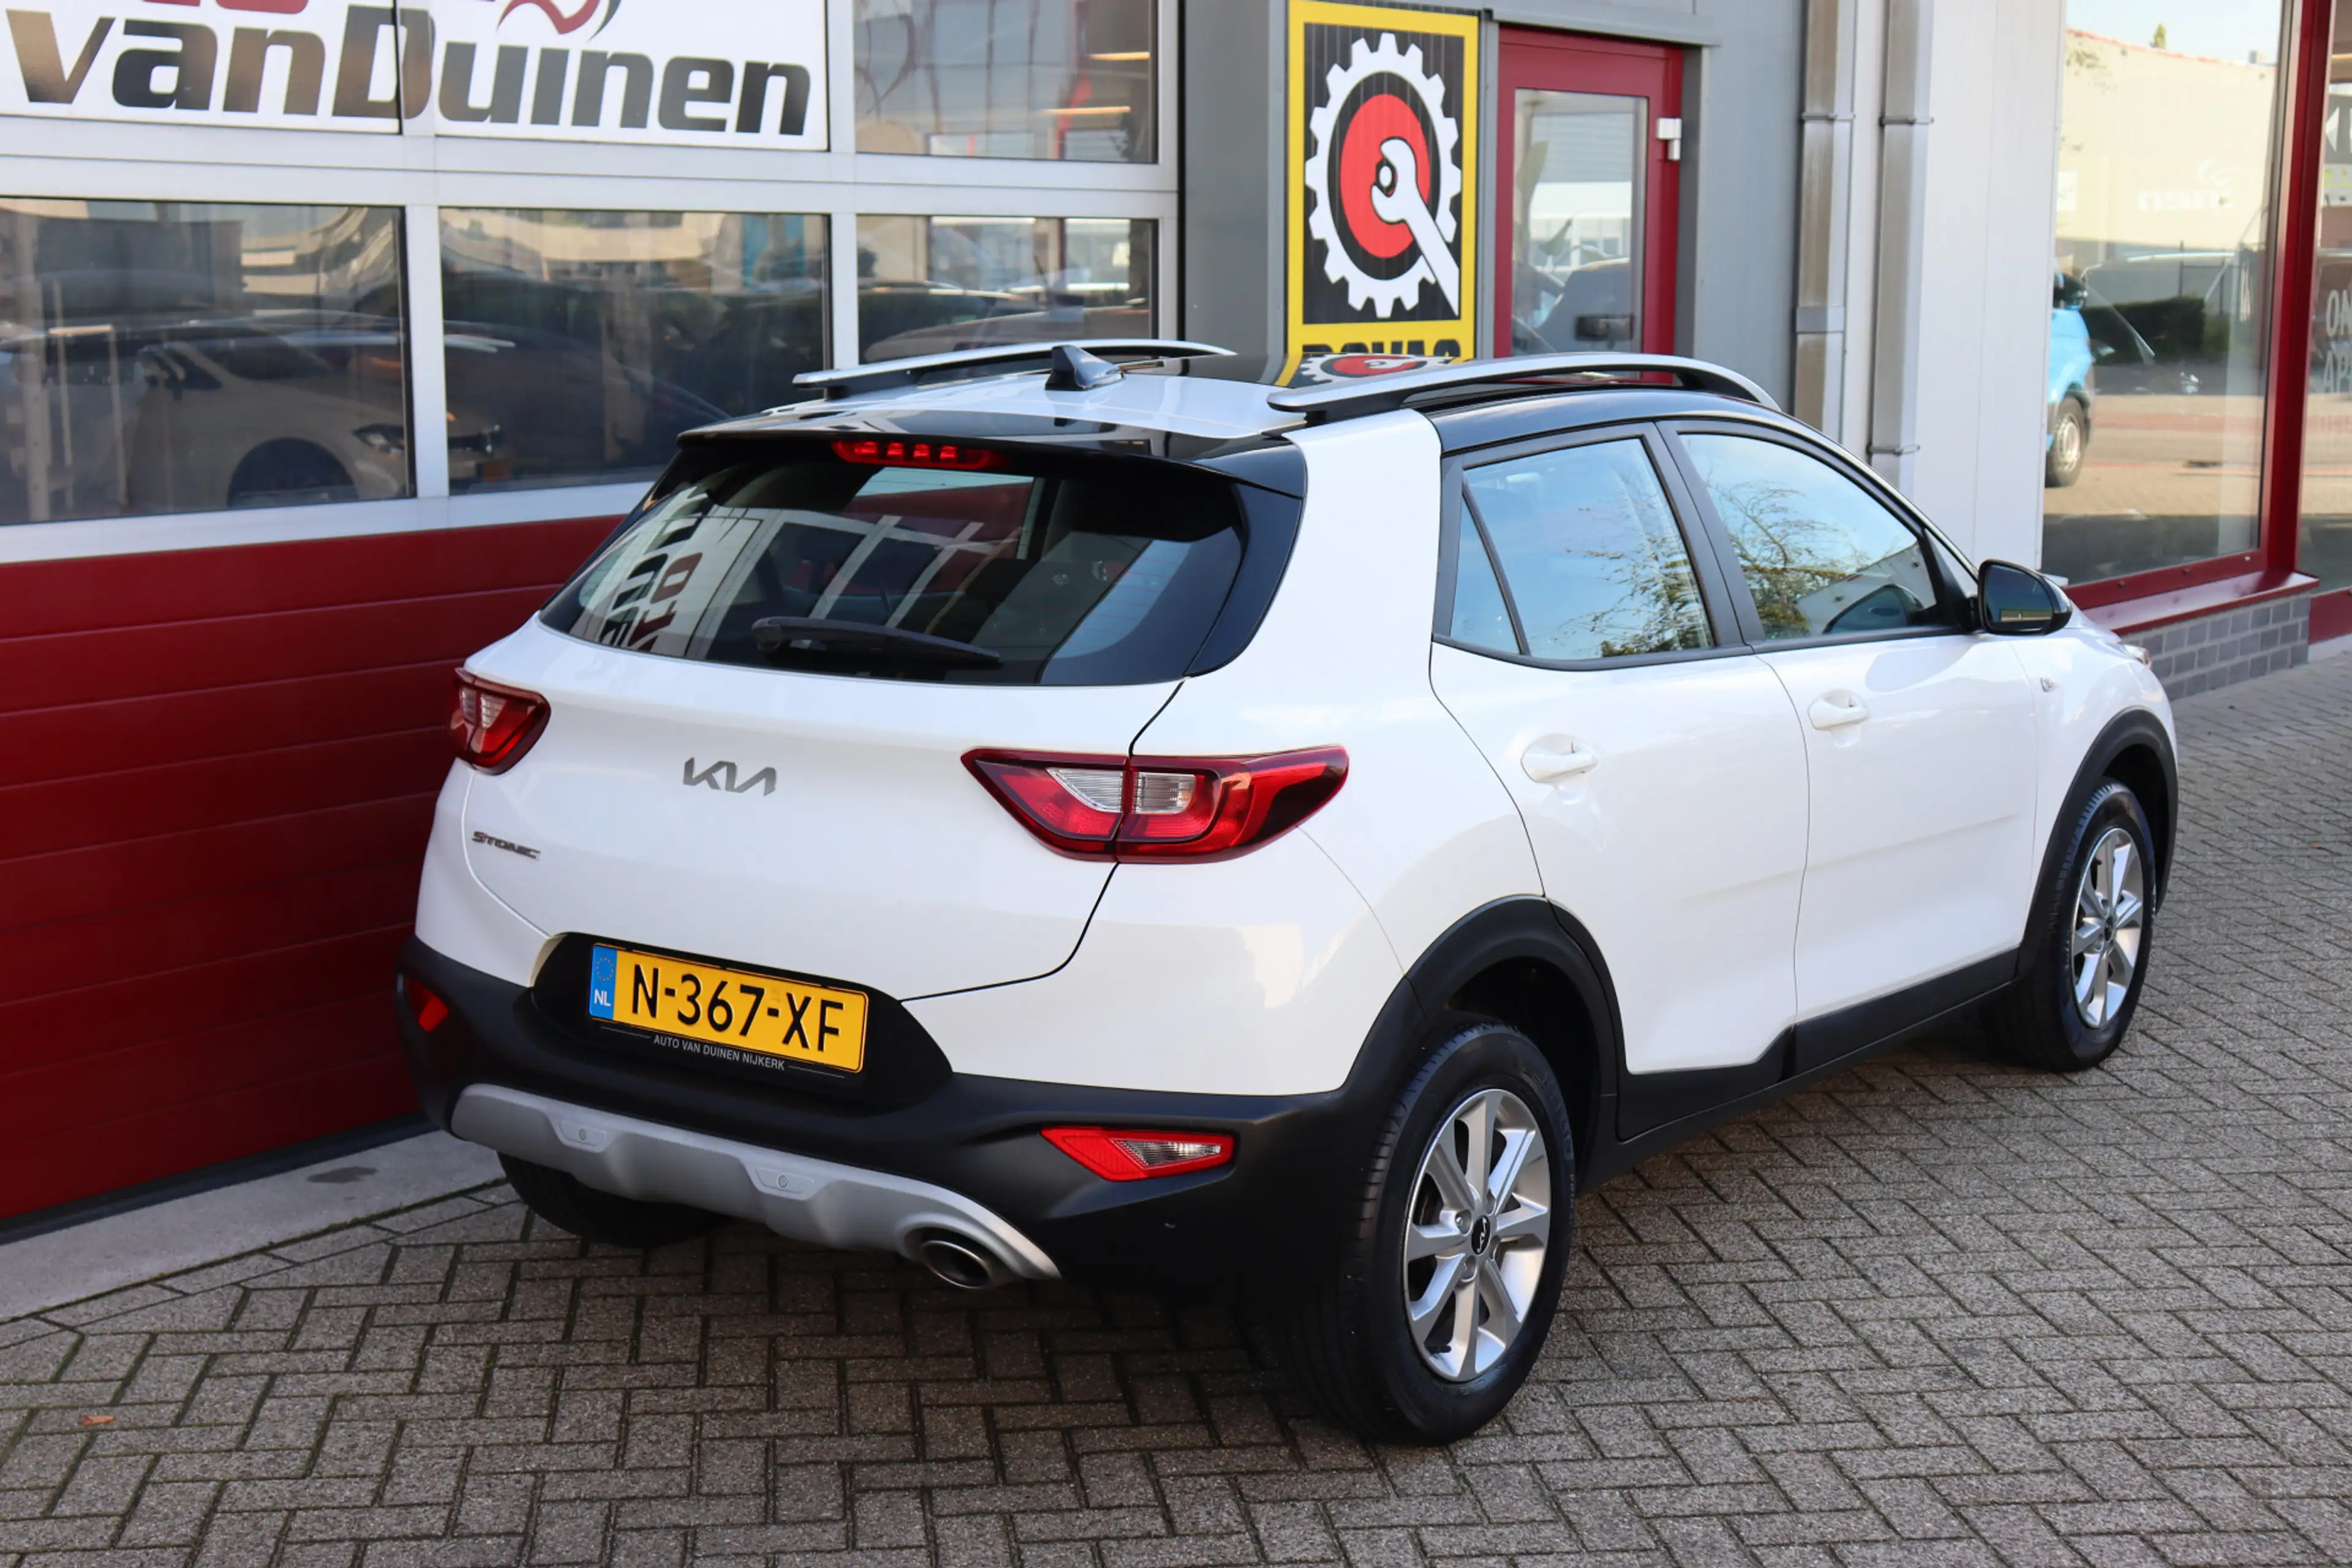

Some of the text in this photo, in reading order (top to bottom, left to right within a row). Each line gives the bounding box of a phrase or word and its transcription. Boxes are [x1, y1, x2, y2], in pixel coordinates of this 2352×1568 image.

[682, 756, 777, 797] KIA
[593, 989, 611, 1008] NL
[632, 963, 844, 1052] N-367-XF
[654, 1034, 785, 1071] AUTO VAN DUINEN NIJKERK
